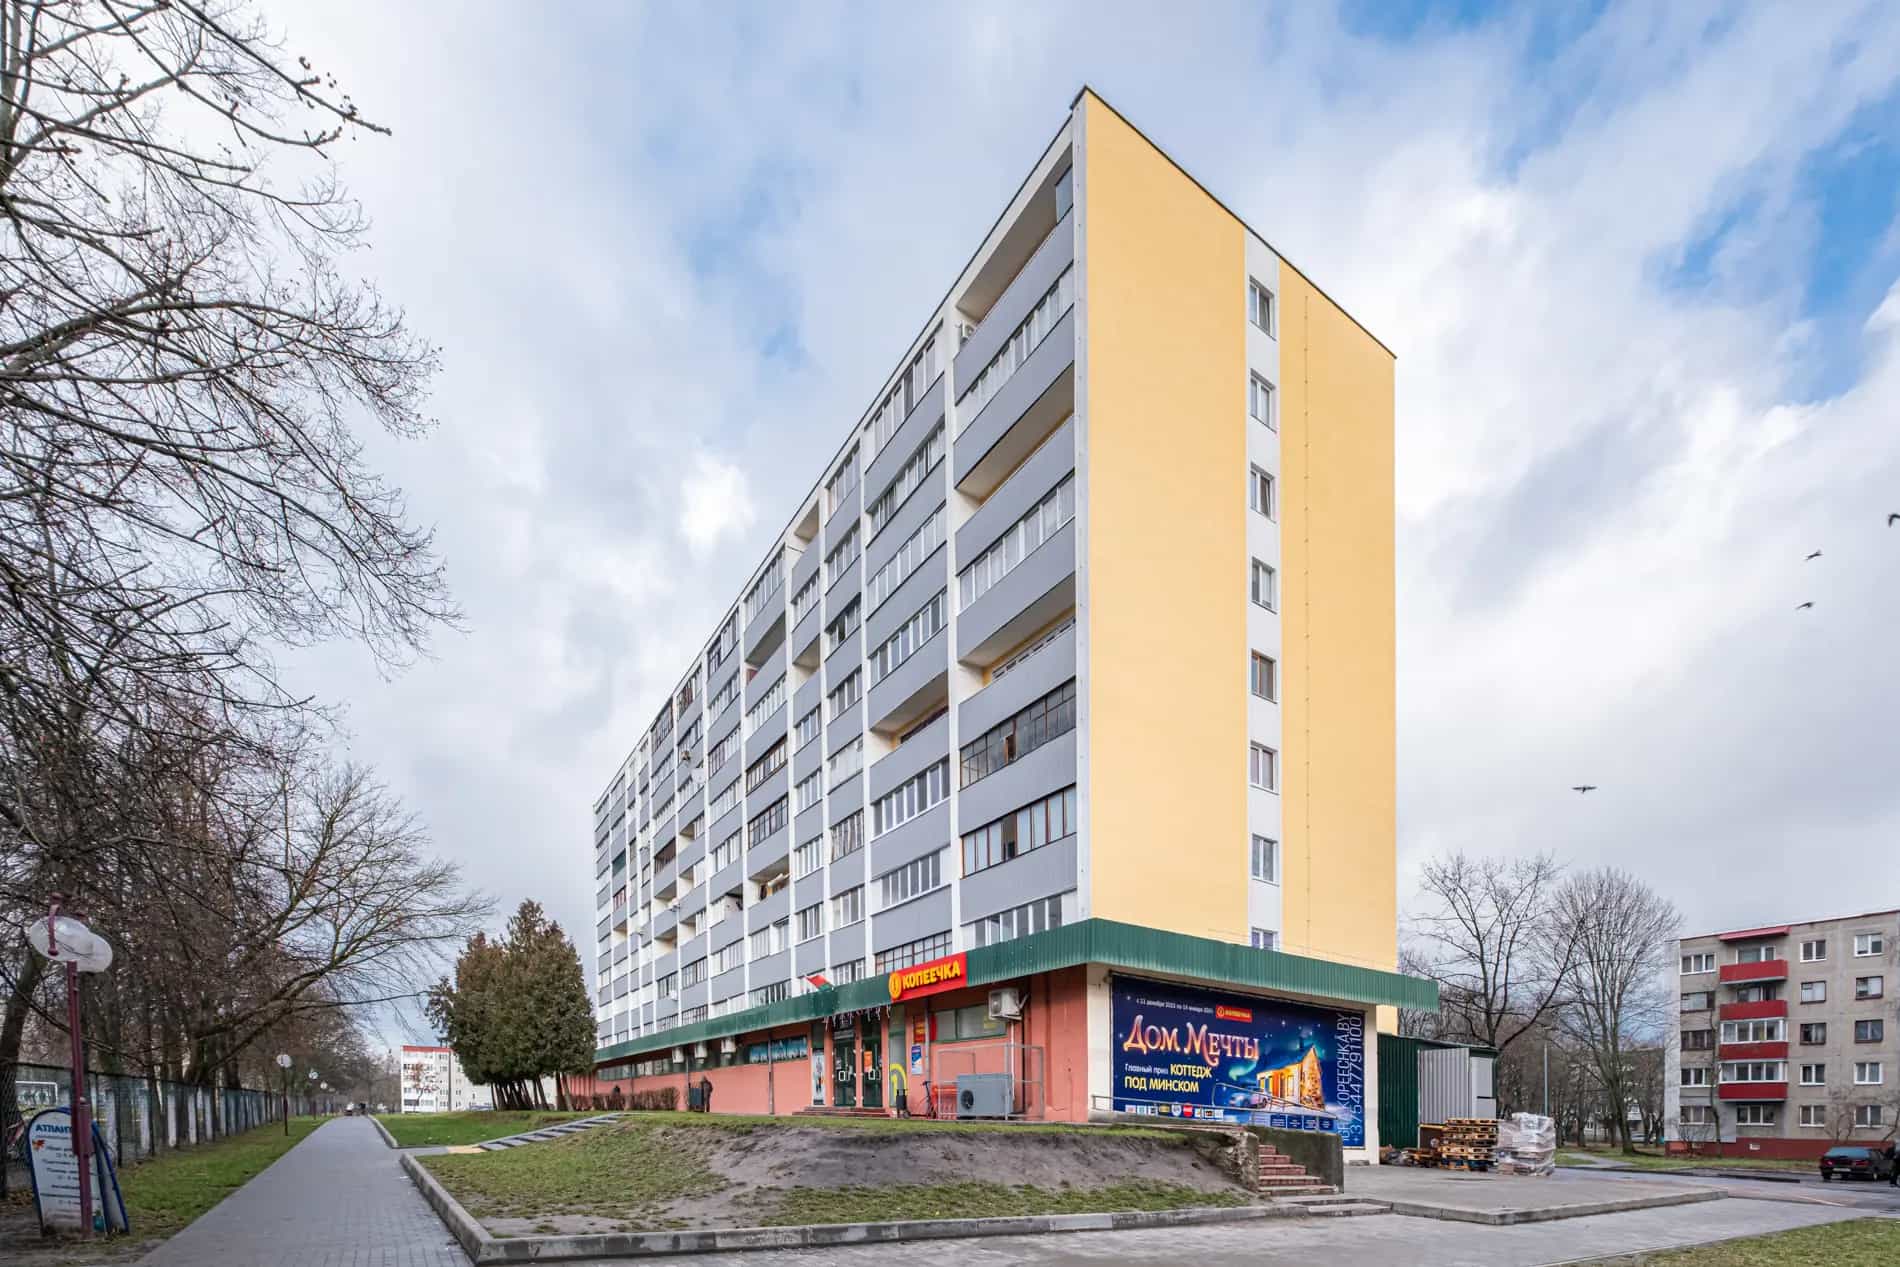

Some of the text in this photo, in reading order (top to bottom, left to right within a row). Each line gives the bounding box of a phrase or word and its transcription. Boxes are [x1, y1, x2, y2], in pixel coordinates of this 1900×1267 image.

[903, 960, 961, 989] КОПЕЕЧКА
[1125, 1063, 1153, 1073] Главный
[1170, 1063, 1213, 1079] КОТТЕДЖ
[1124, 1075, 1200, 1094] ПОД МИНСКОМ
